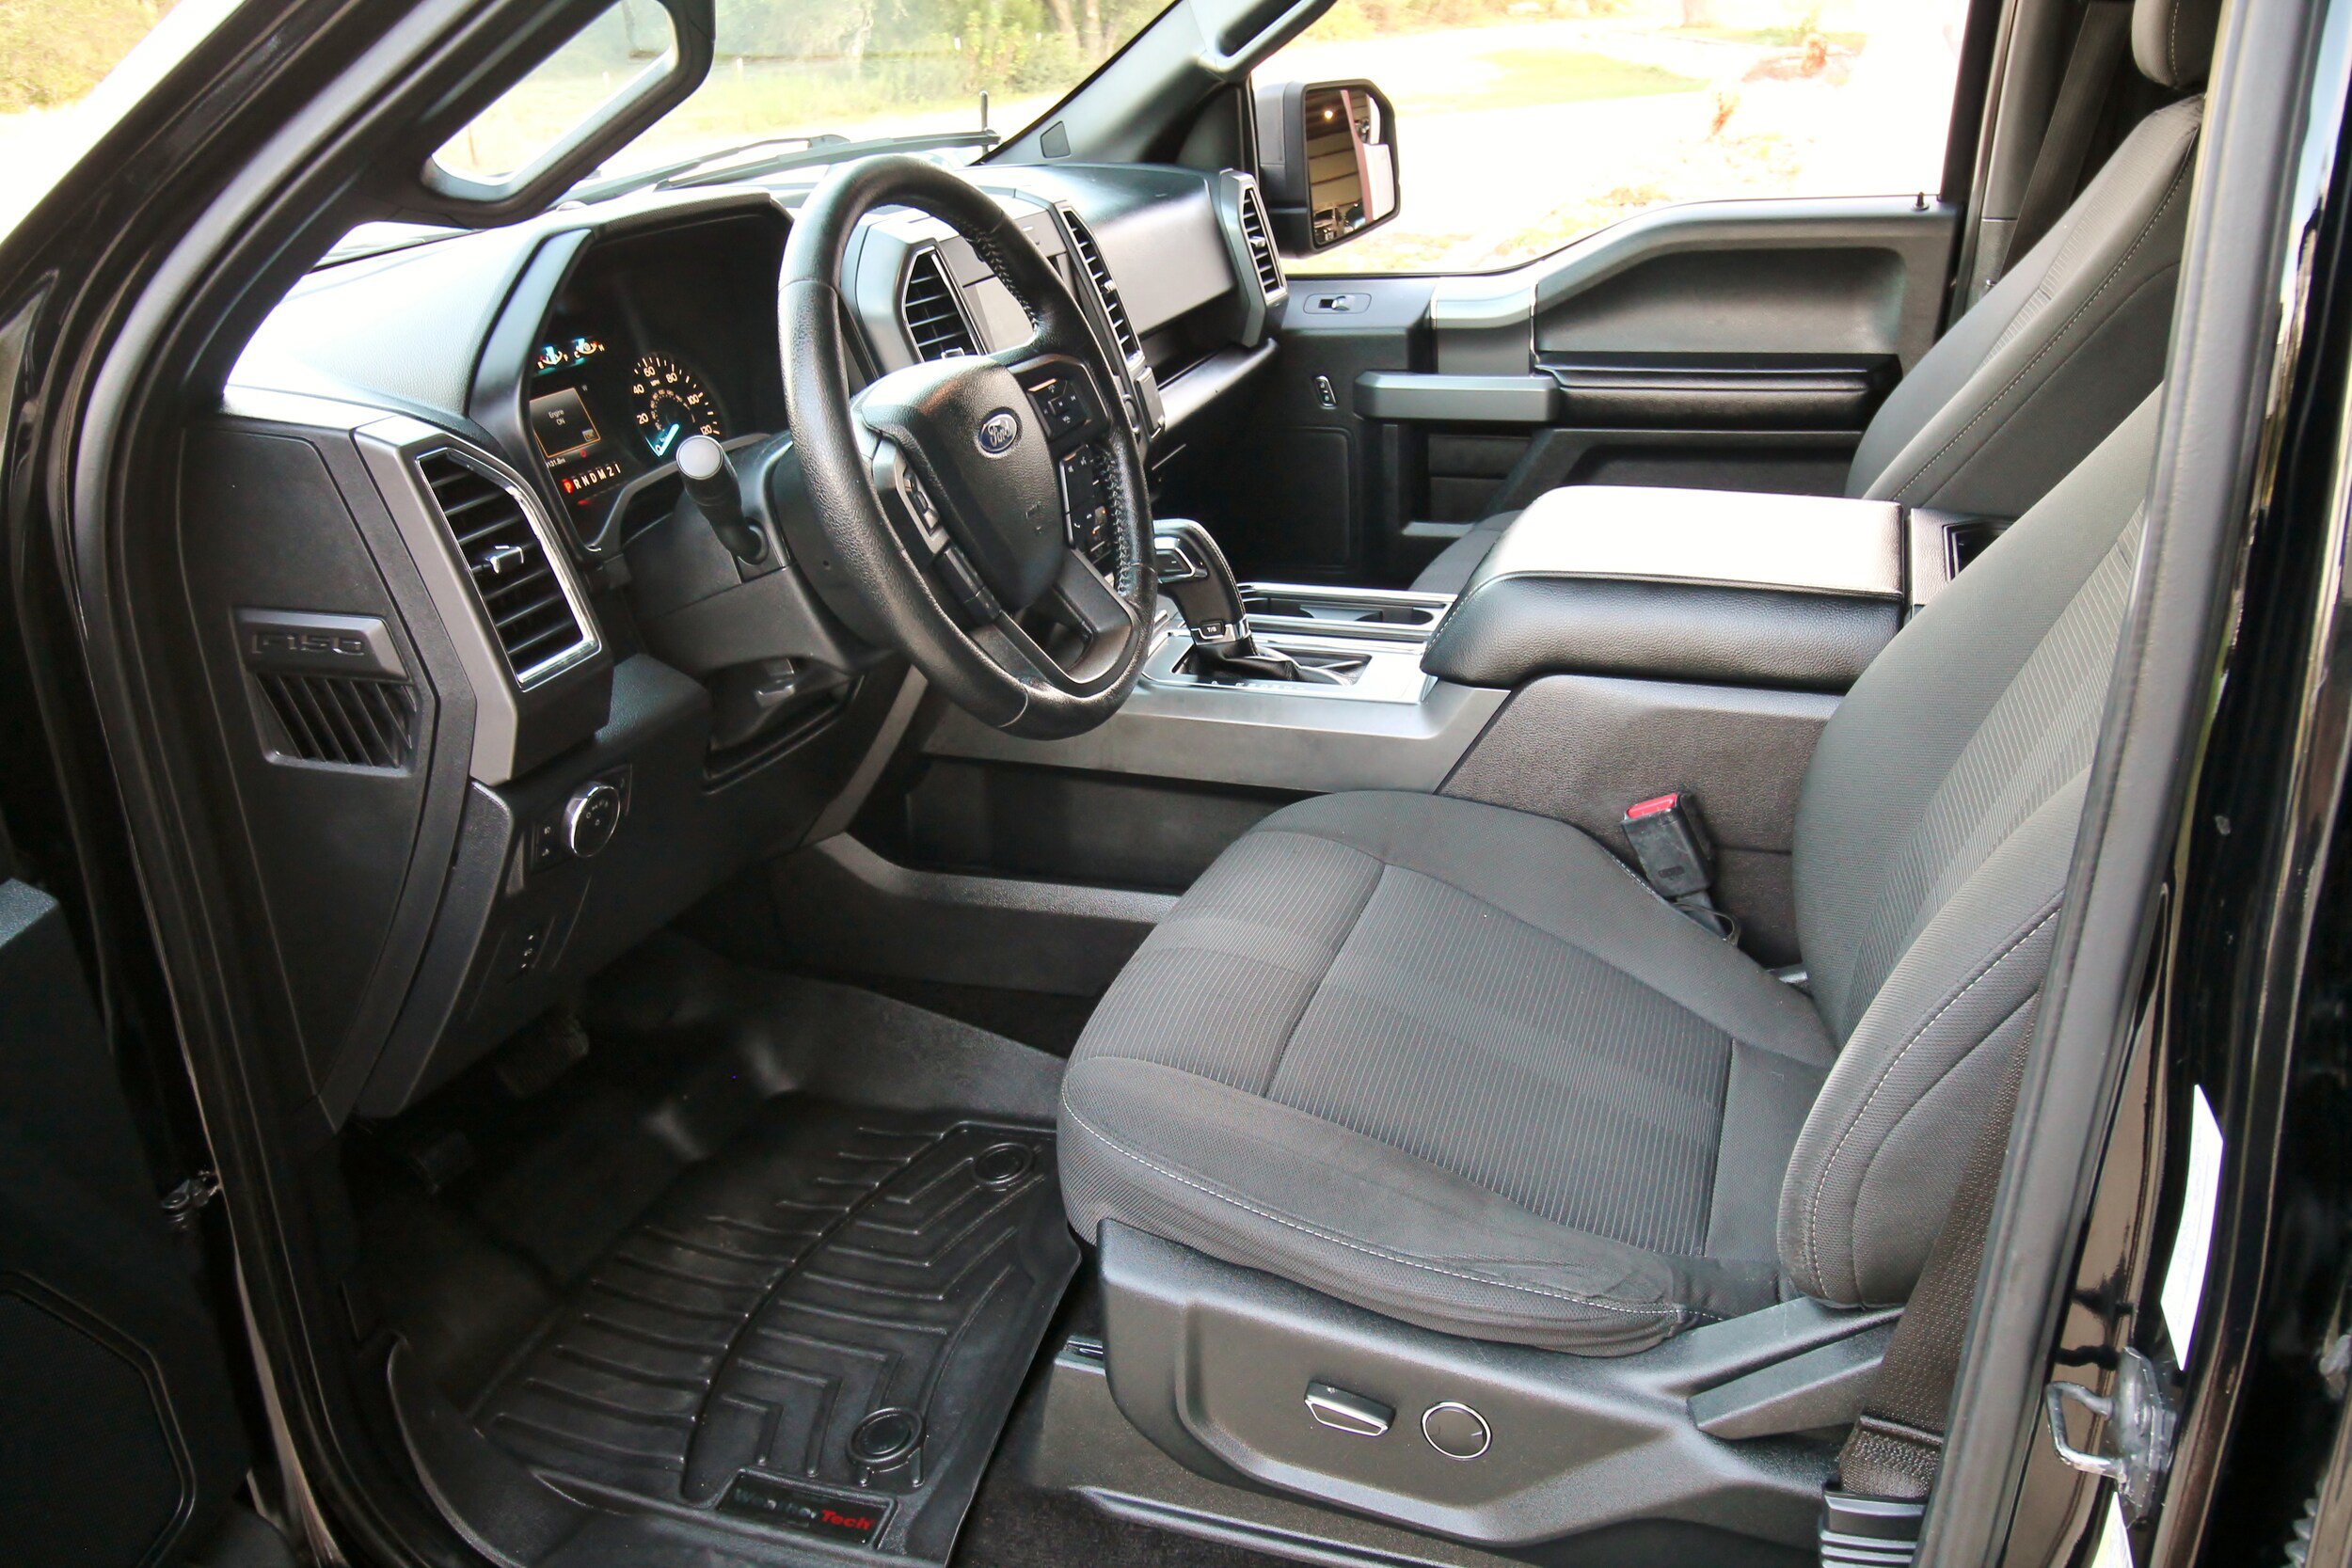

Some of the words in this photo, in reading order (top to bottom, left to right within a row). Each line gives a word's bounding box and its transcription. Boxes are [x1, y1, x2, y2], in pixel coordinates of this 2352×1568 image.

[643, 366, 656, 377] 60
[665, 372, 677, 383] 80
[633, 384, 644, 394] 40
[687, 393, 700, 404] 100
[548, 409, 564, 419] Engine
[636, 413, 649, 424] 20
[556, 418, 565, 426] ON
[700, 424, 712, 436] 120
[988, 420, 1012, 447] Ford
